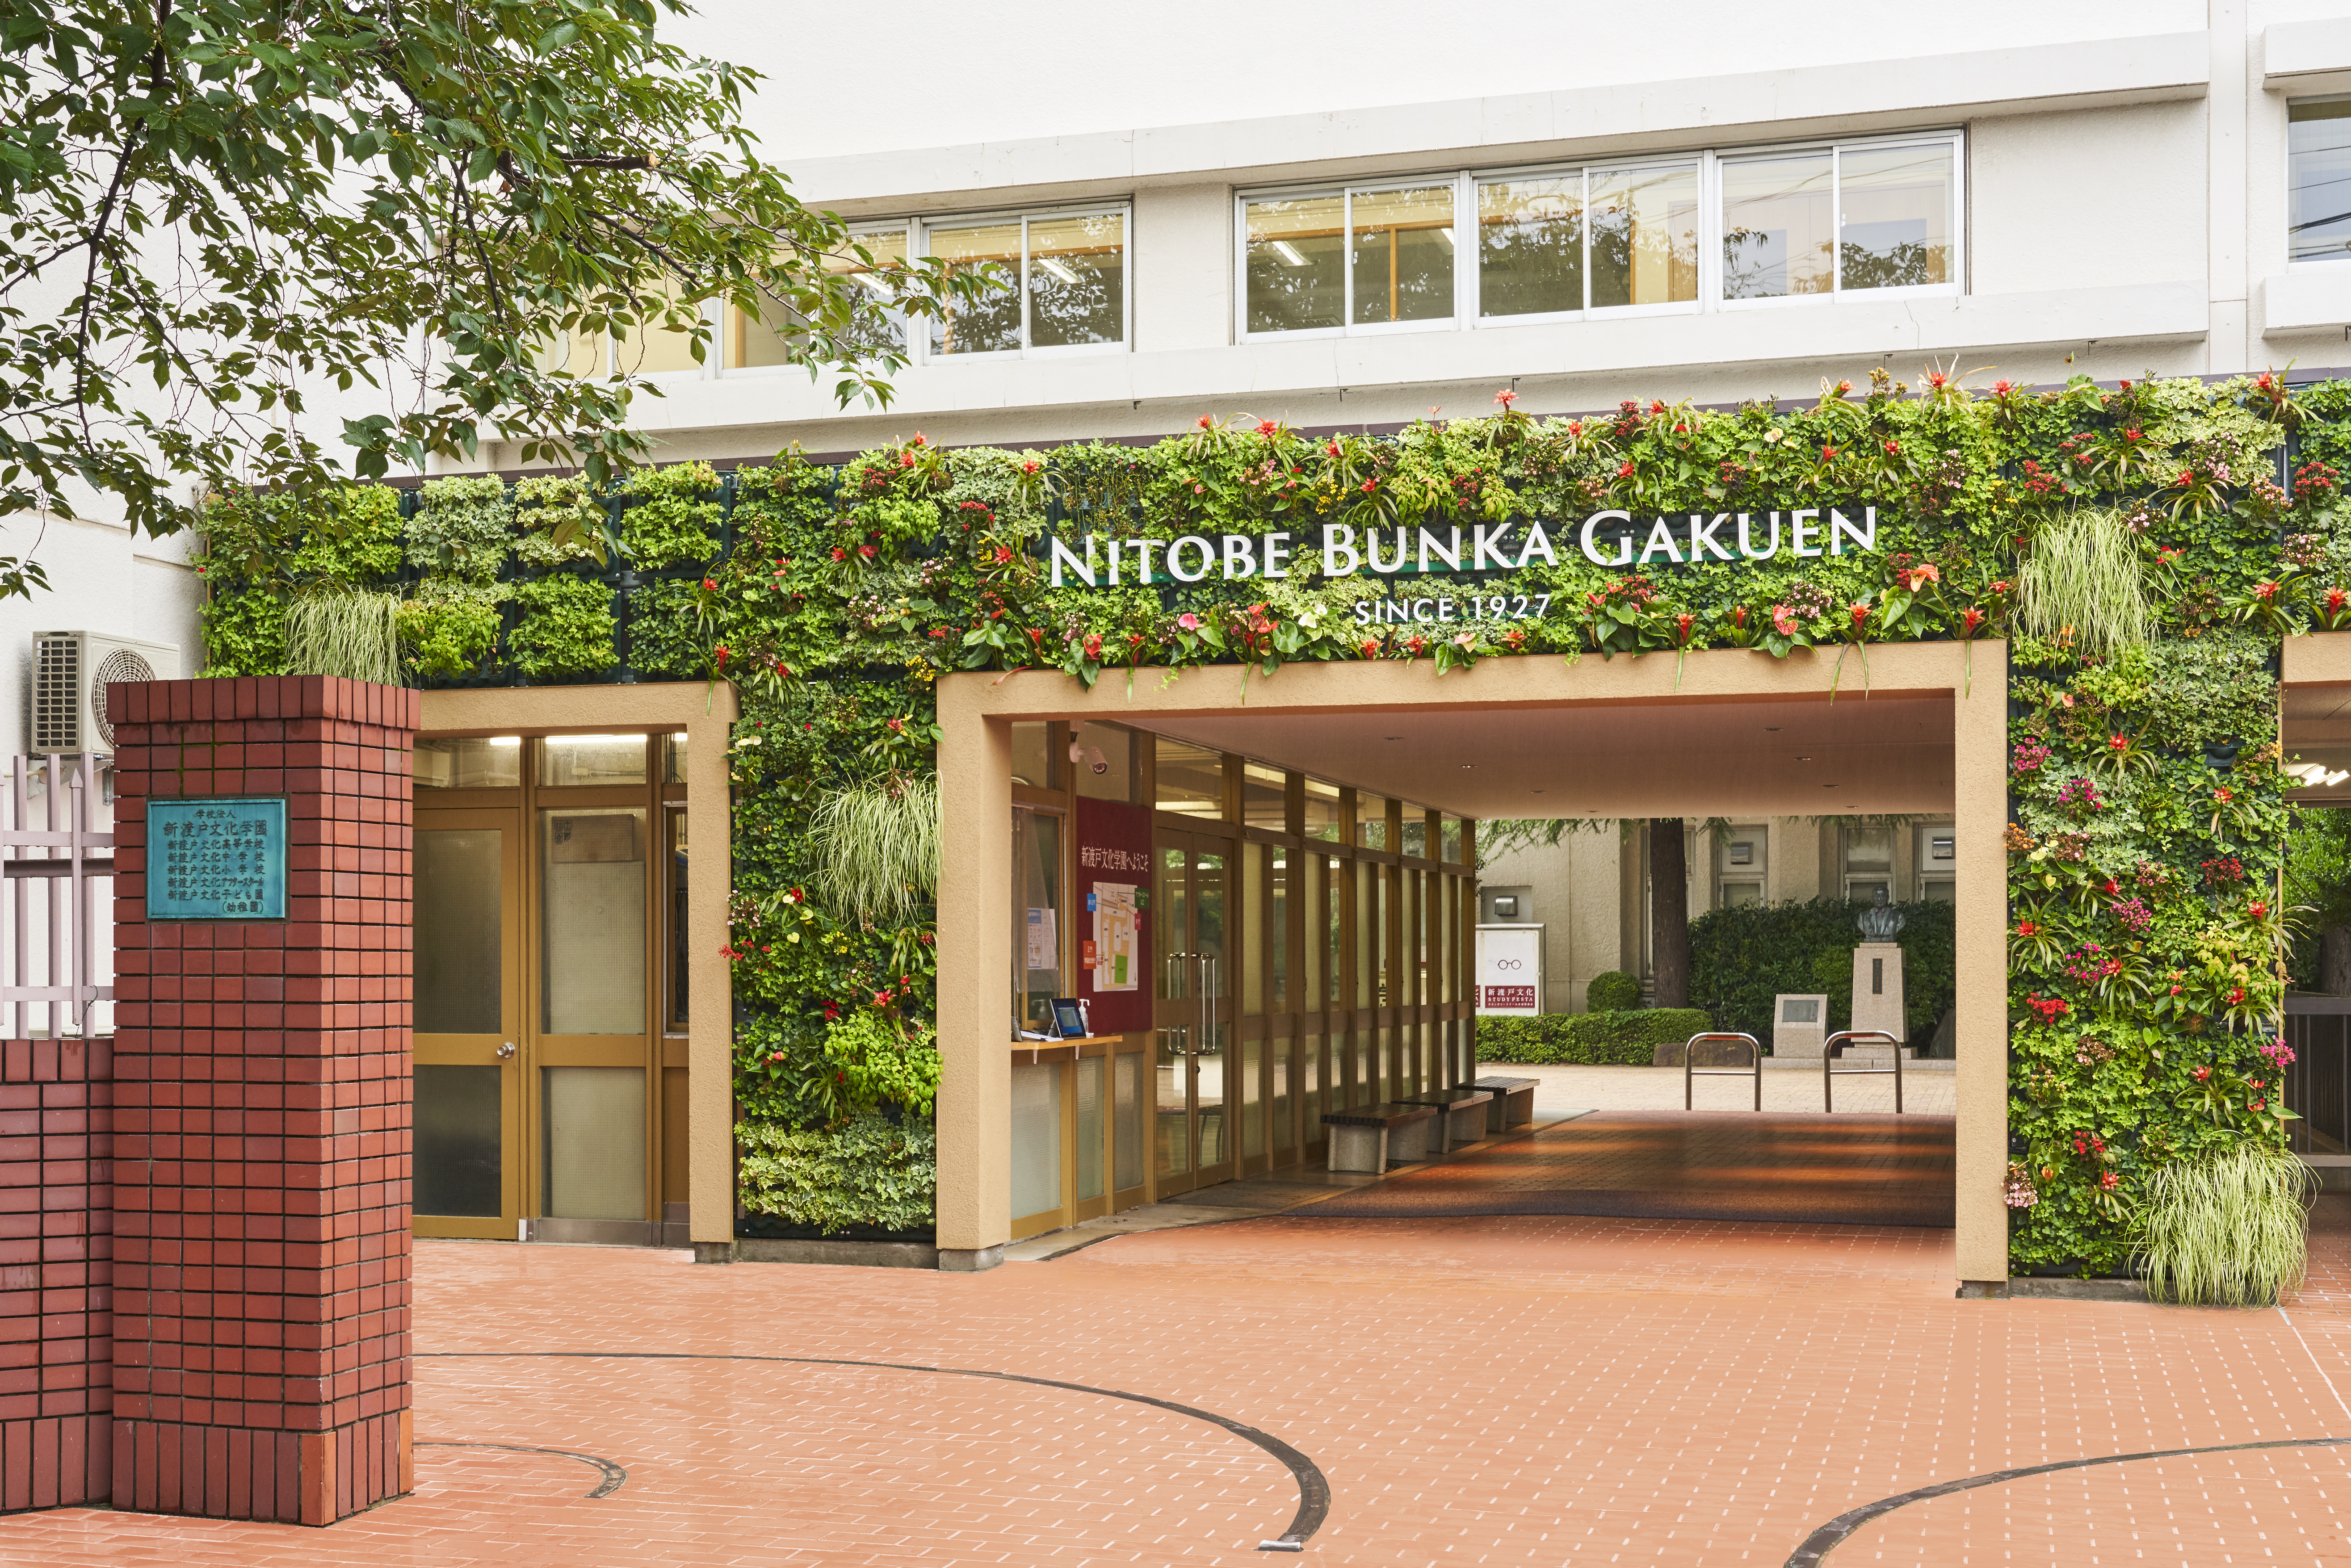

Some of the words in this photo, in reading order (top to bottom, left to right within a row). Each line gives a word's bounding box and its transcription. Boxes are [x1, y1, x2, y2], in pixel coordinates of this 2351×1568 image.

[1051, 532, 1290, 587] NITOBE
[1323, 520, 1559, 577] BUNKA
[1580, 506, 1877, 566] GAKUEN
[1355, 597, 1453, 625] SINCE
[1471, 593, 1550, 620] 1927
[195, 809, 237, 819] 学校法人
[163, 819, 267, 838] 新渡戸文化学園
[1081, 846, 1148, 872] 新渡戸文化学園へようこそ
